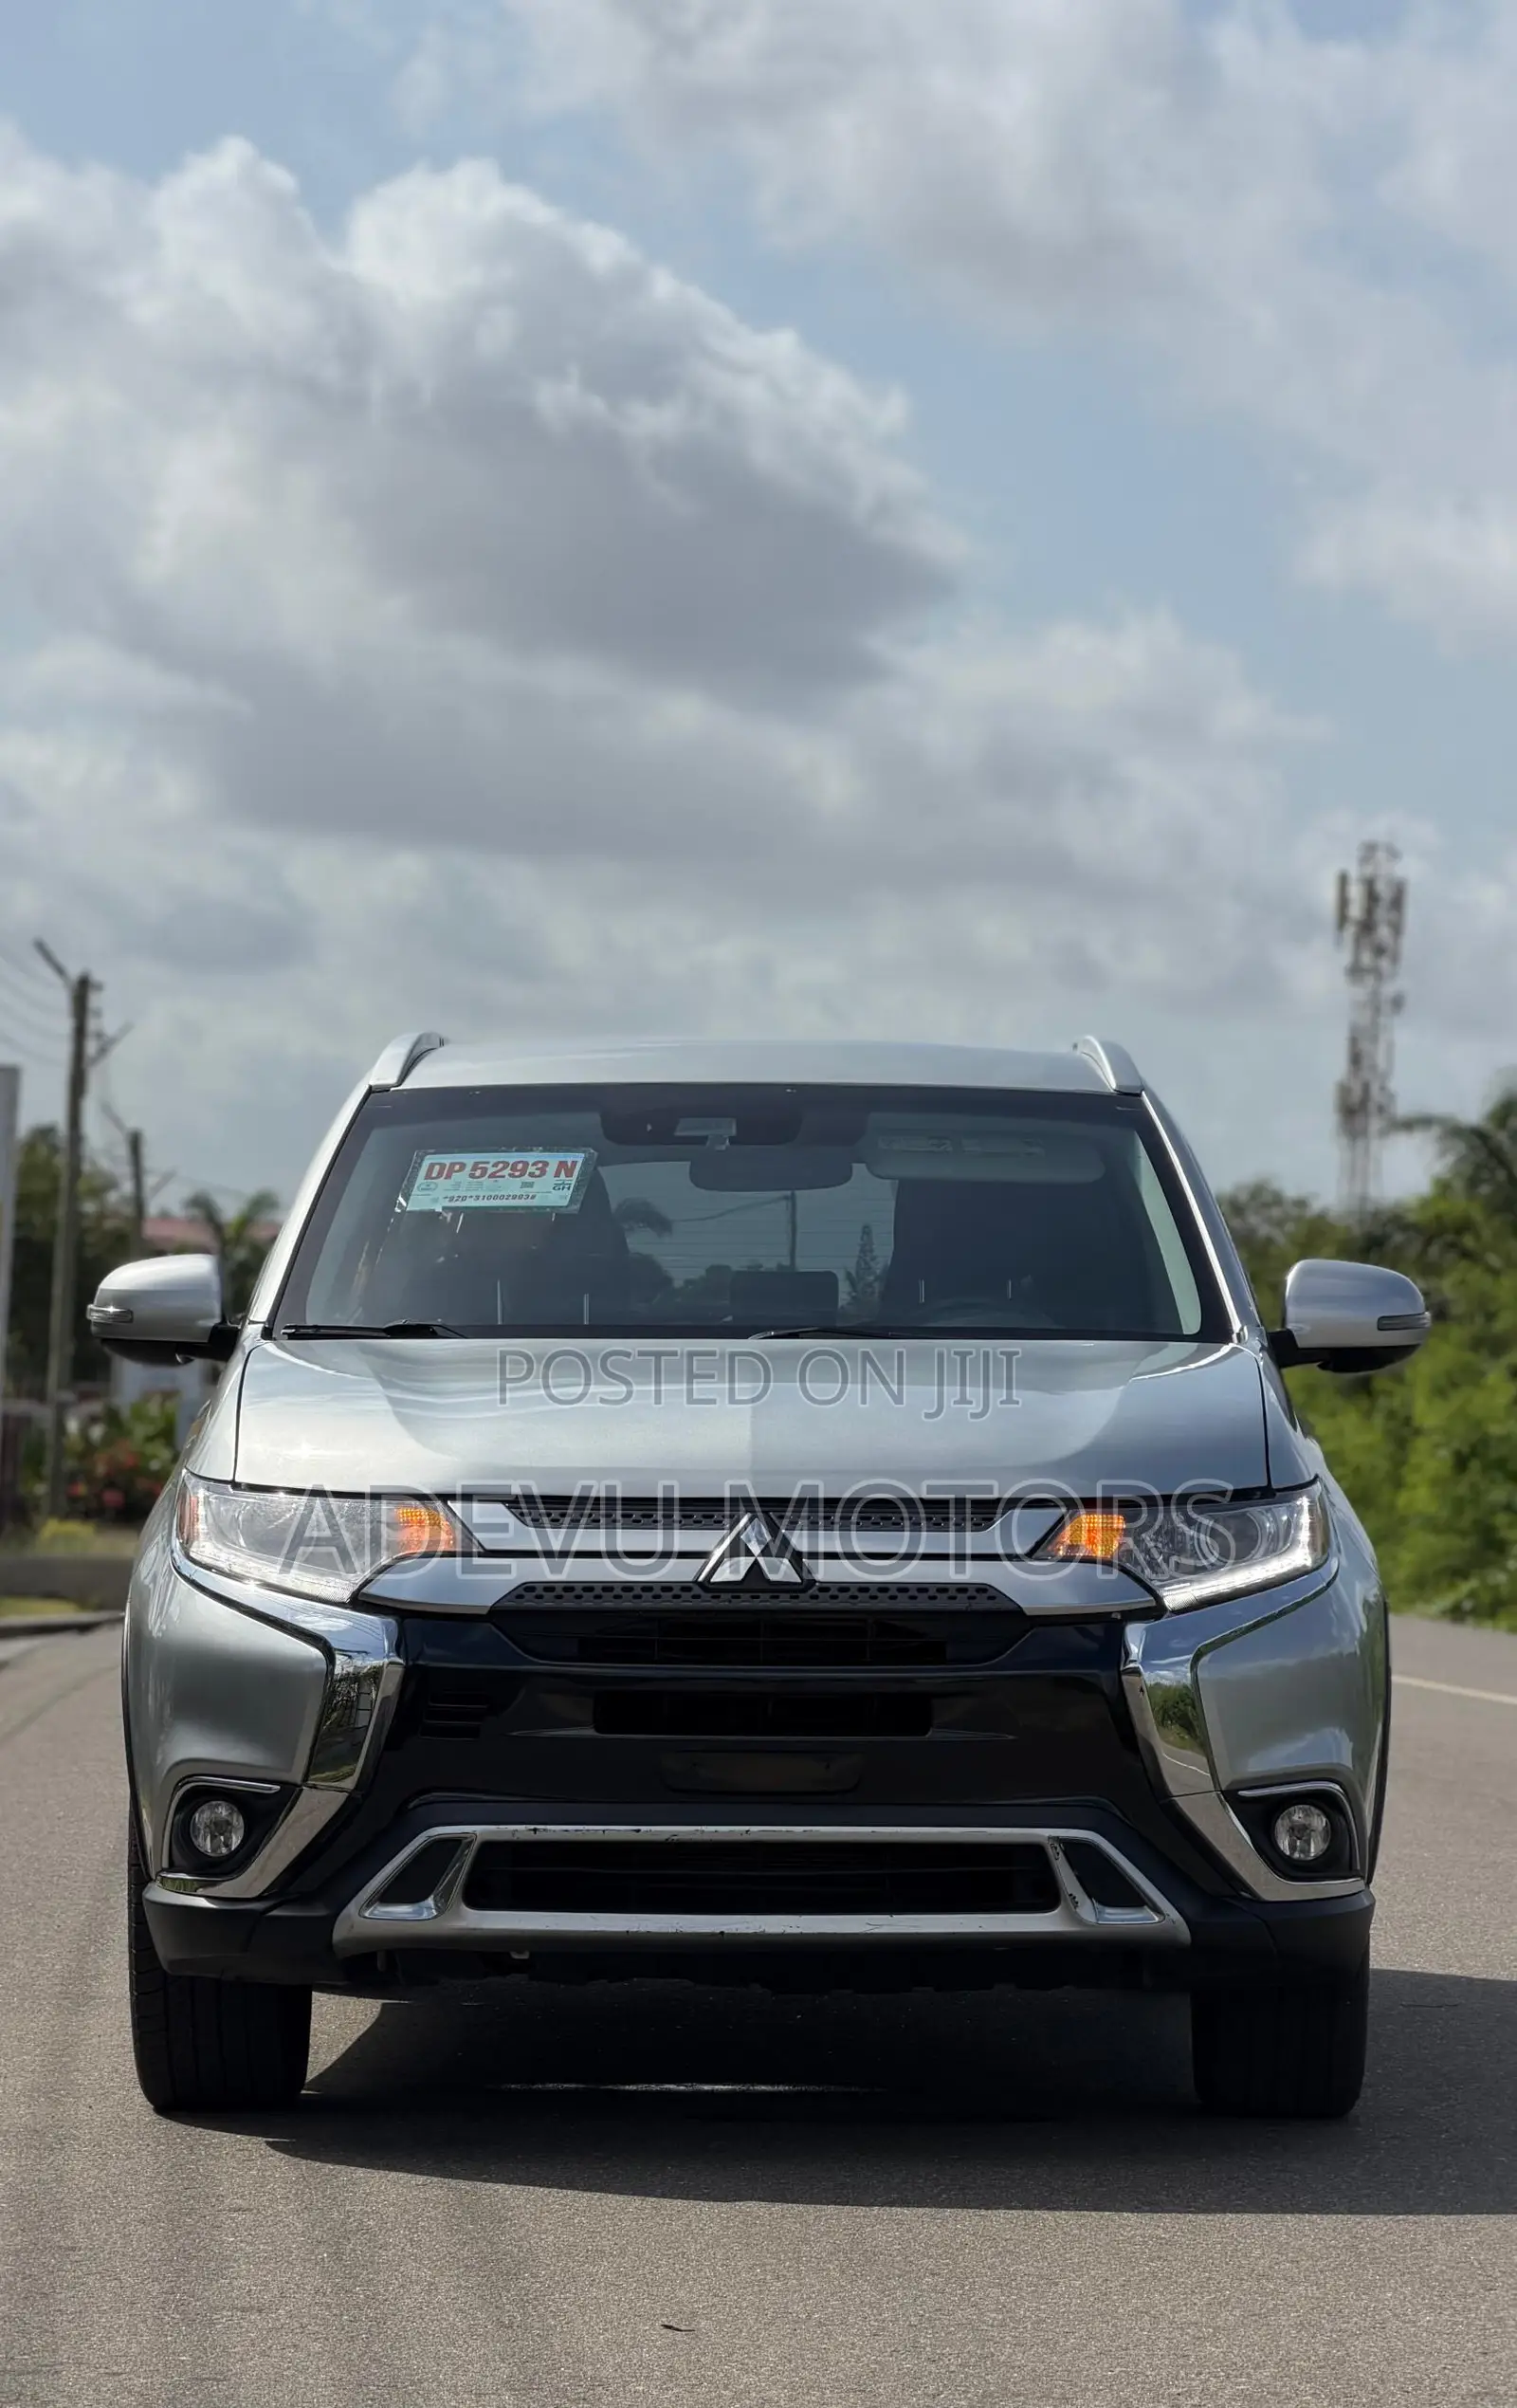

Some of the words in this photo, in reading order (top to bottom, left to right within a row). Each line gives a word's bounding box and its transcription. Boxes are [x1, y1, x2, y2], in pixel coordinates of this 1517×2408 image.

[424, 1162, 466, 1180] DP
[468, 1161, 549, 1179] 5293
[554, 1160, 578, 1178] N
